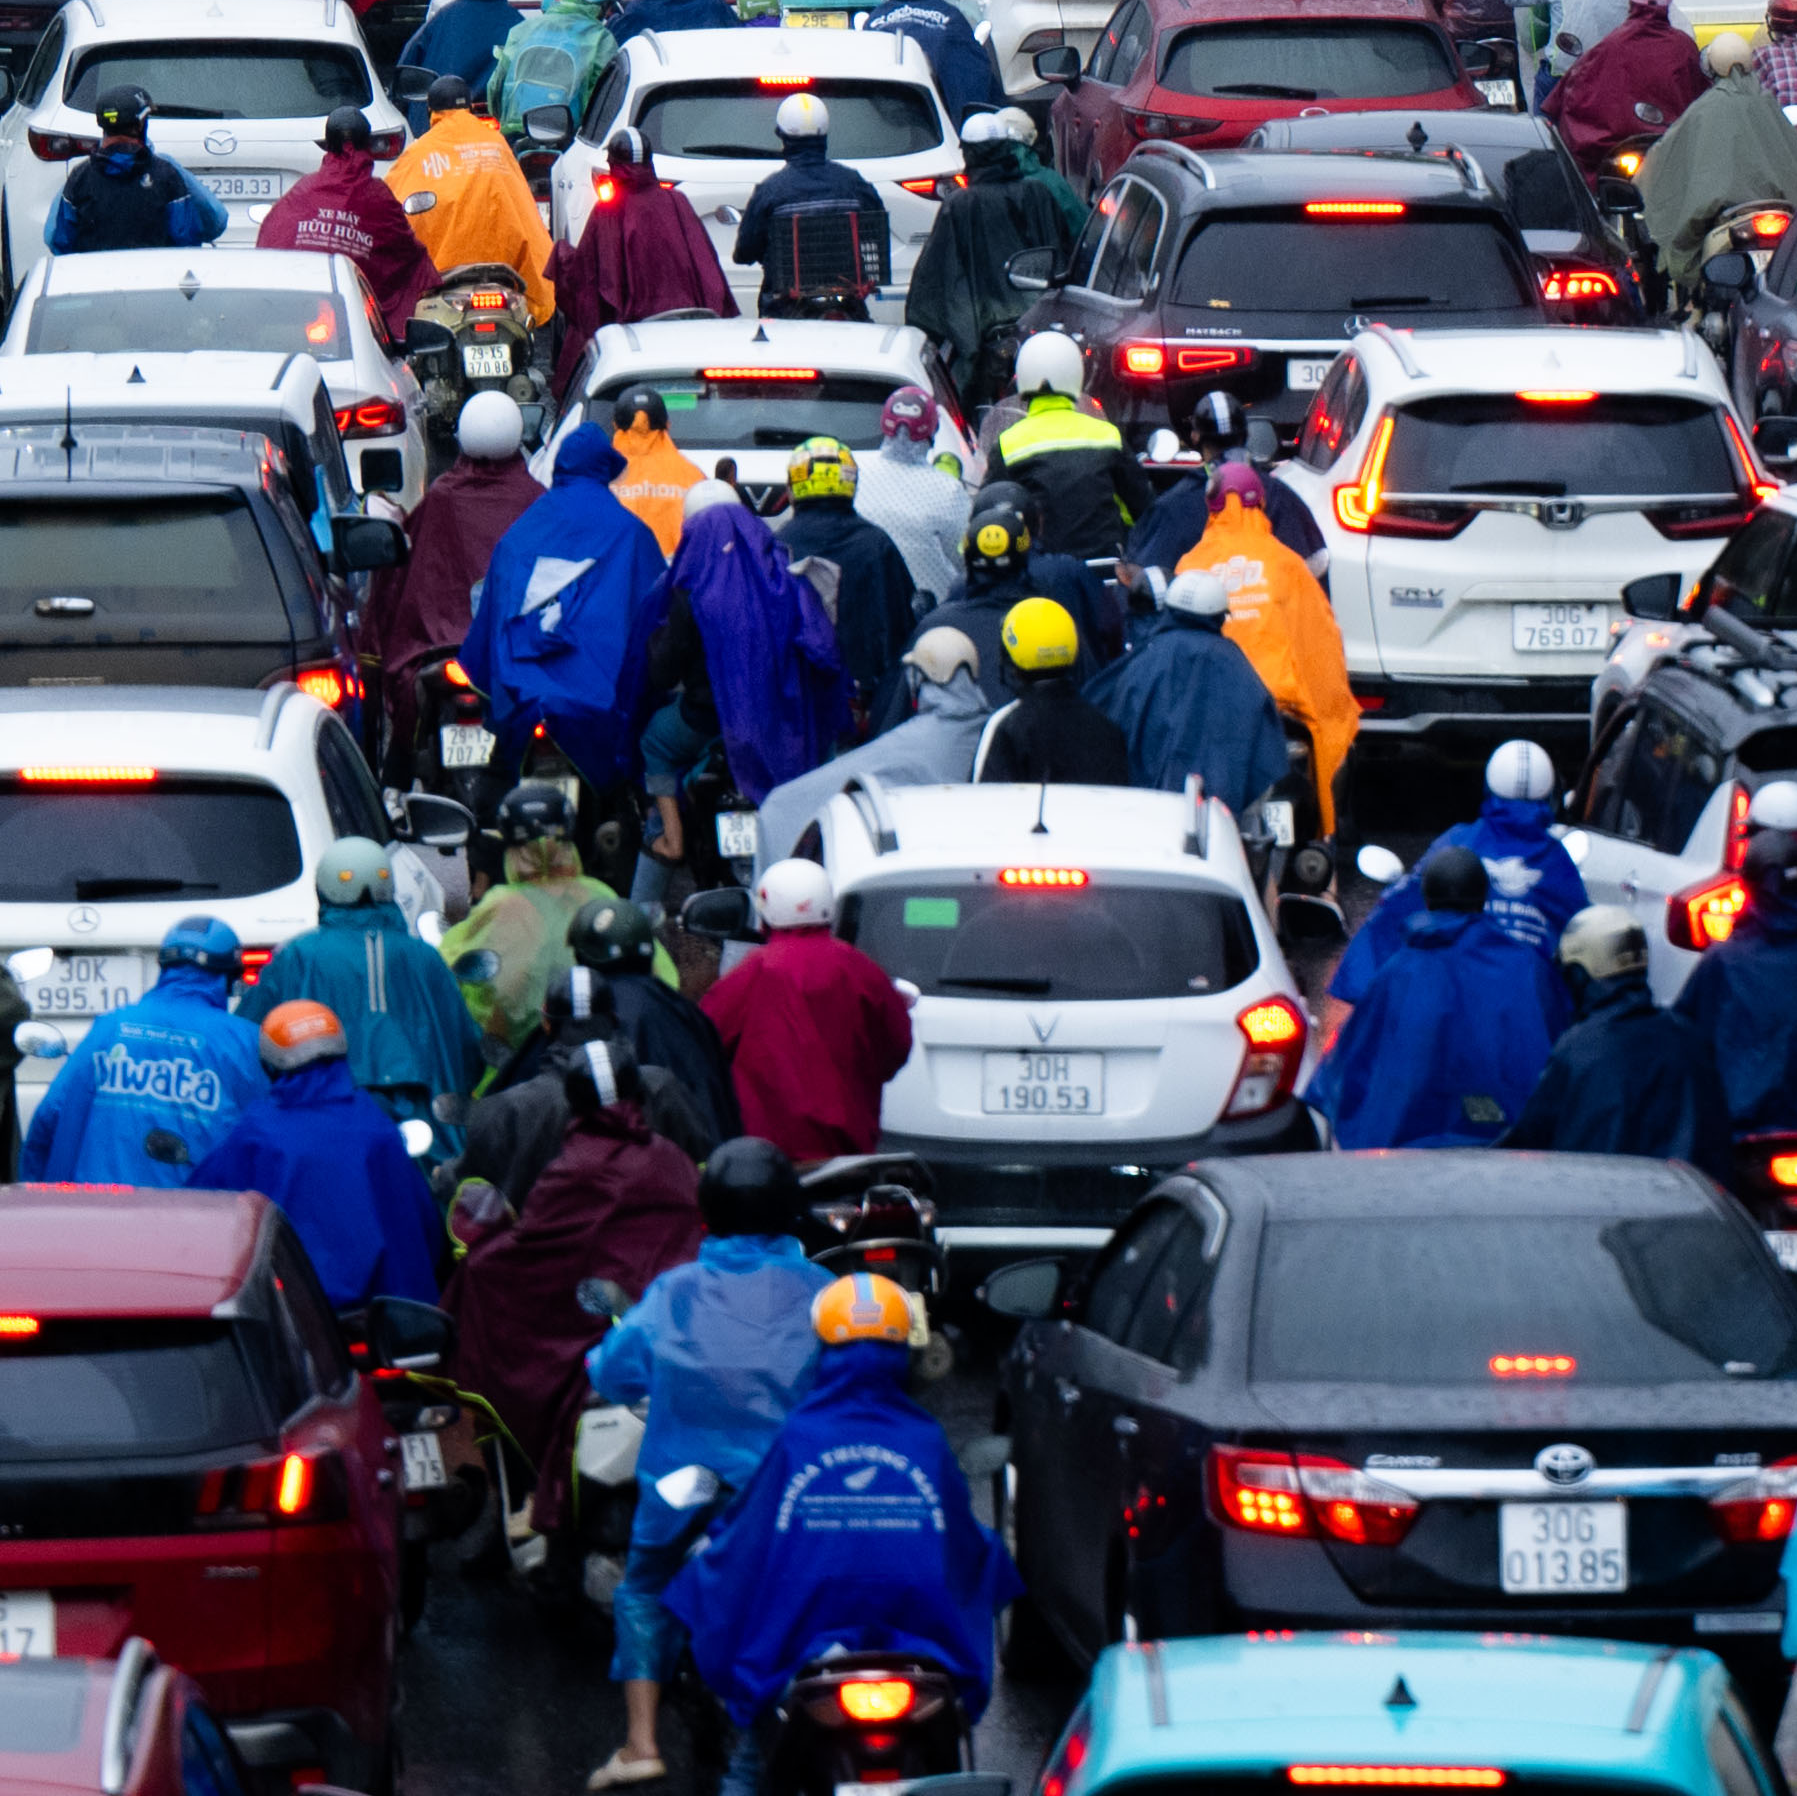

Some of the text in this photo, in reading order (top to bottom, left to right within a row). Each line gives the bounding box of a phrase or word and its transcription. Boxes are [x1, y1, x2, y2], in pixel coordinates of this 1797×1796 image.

[318, 208, 361, 224] XE MÁY
[297, 217, 332, 234] HỮU
[334, 223, 374, 247] HÙNG
[1186, 327, 1242, 336] MAYBACH
[1391, 587, 1444, 602] CR-V
[1542, 606, 1585, 626] 30G
[1524, 626, 1599, 648] 769.07
[59, 958, 107, 983] 30K
[38, 986, 129, 1010] 995.10
[1017, 1055, 1071, 1084] 30H
[997, 1084, 1092, 1113] 190.53
[1531, 1502, 1596, 1545] 30G
[1506, 1545, 1621, 1589] 013.85
